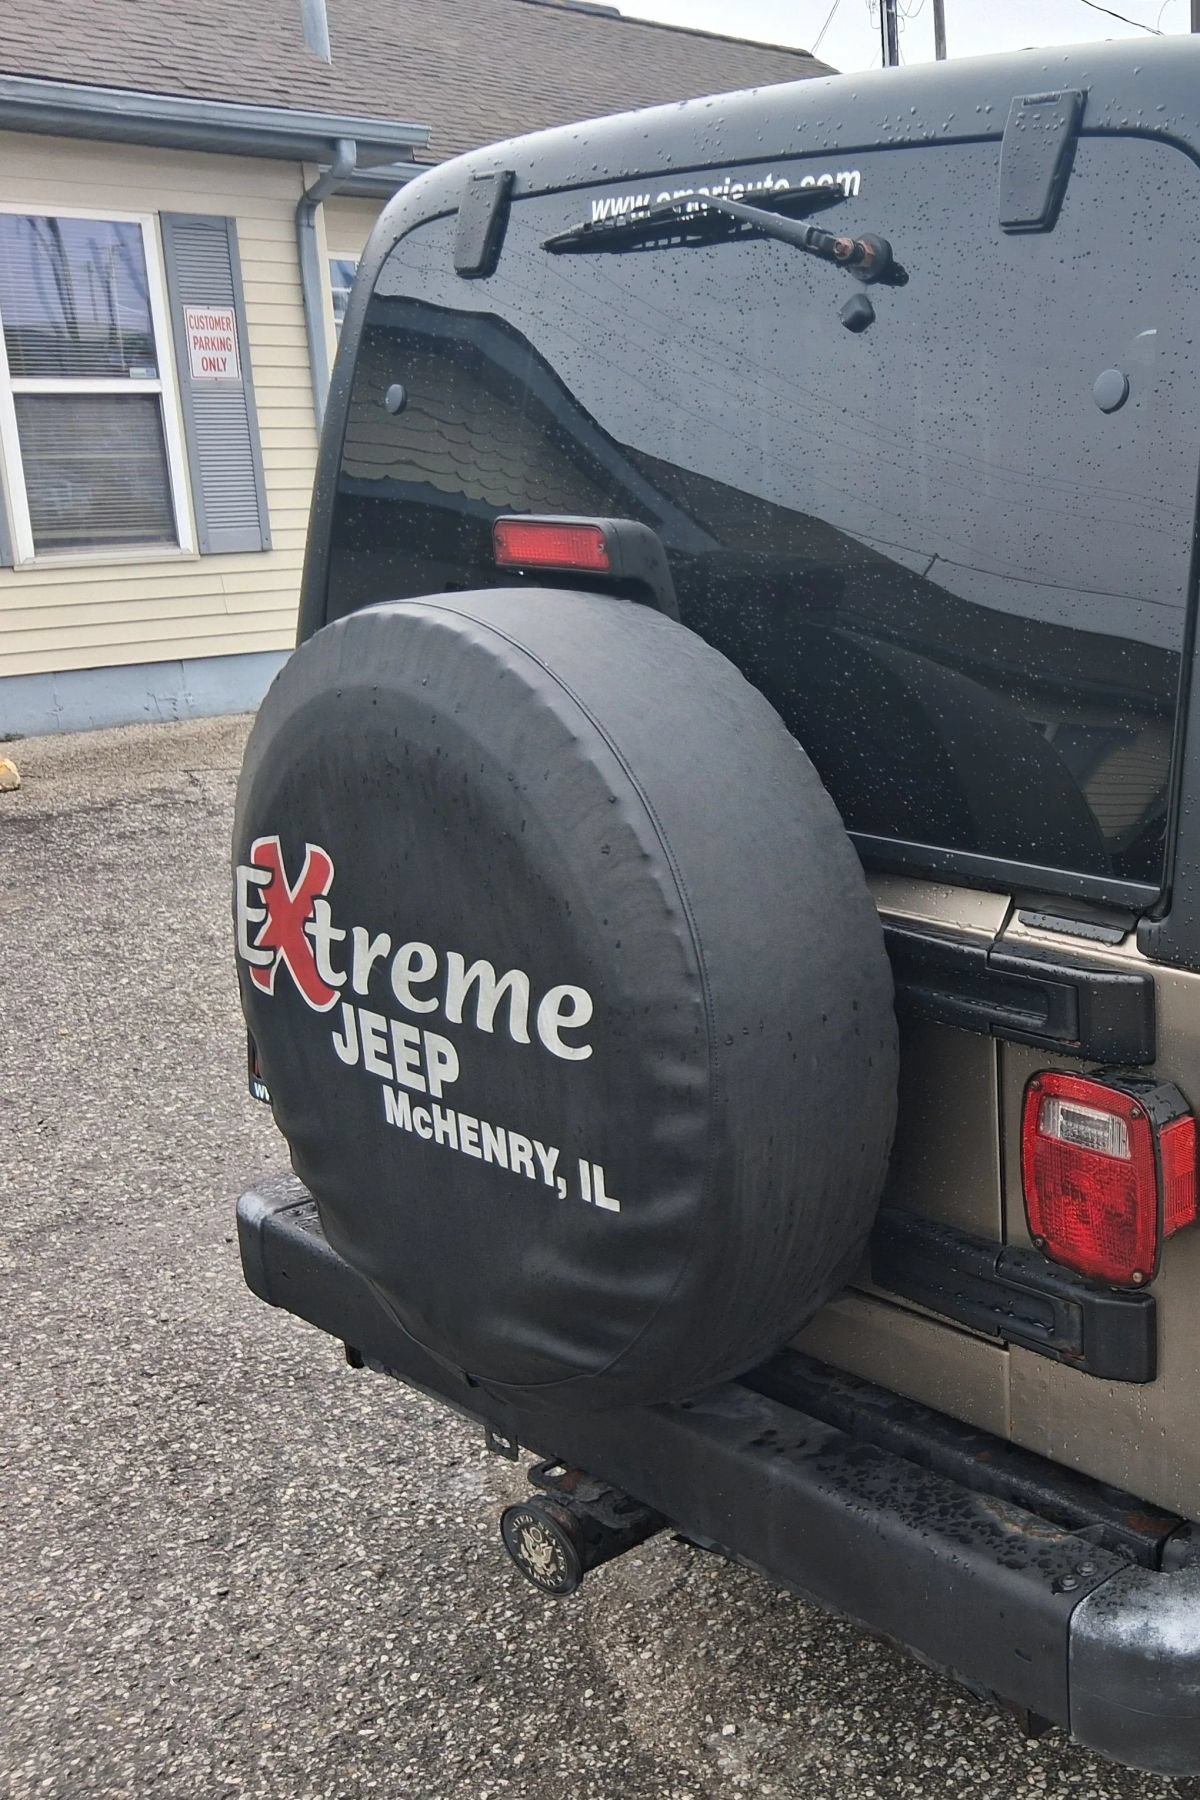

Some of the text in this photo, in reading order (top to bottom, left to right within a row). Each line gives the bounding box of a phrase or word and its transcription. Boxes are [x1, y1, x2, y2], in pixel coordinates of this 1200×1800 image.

[189, 315, 232, 331] CUSTOMER
[193, 336, 232, 352] PARKING
[201, 357, 227, 372] ONLY
[331, 1002, 460, 1098] JEEP
[578, 1158, 621, 1213] IL
